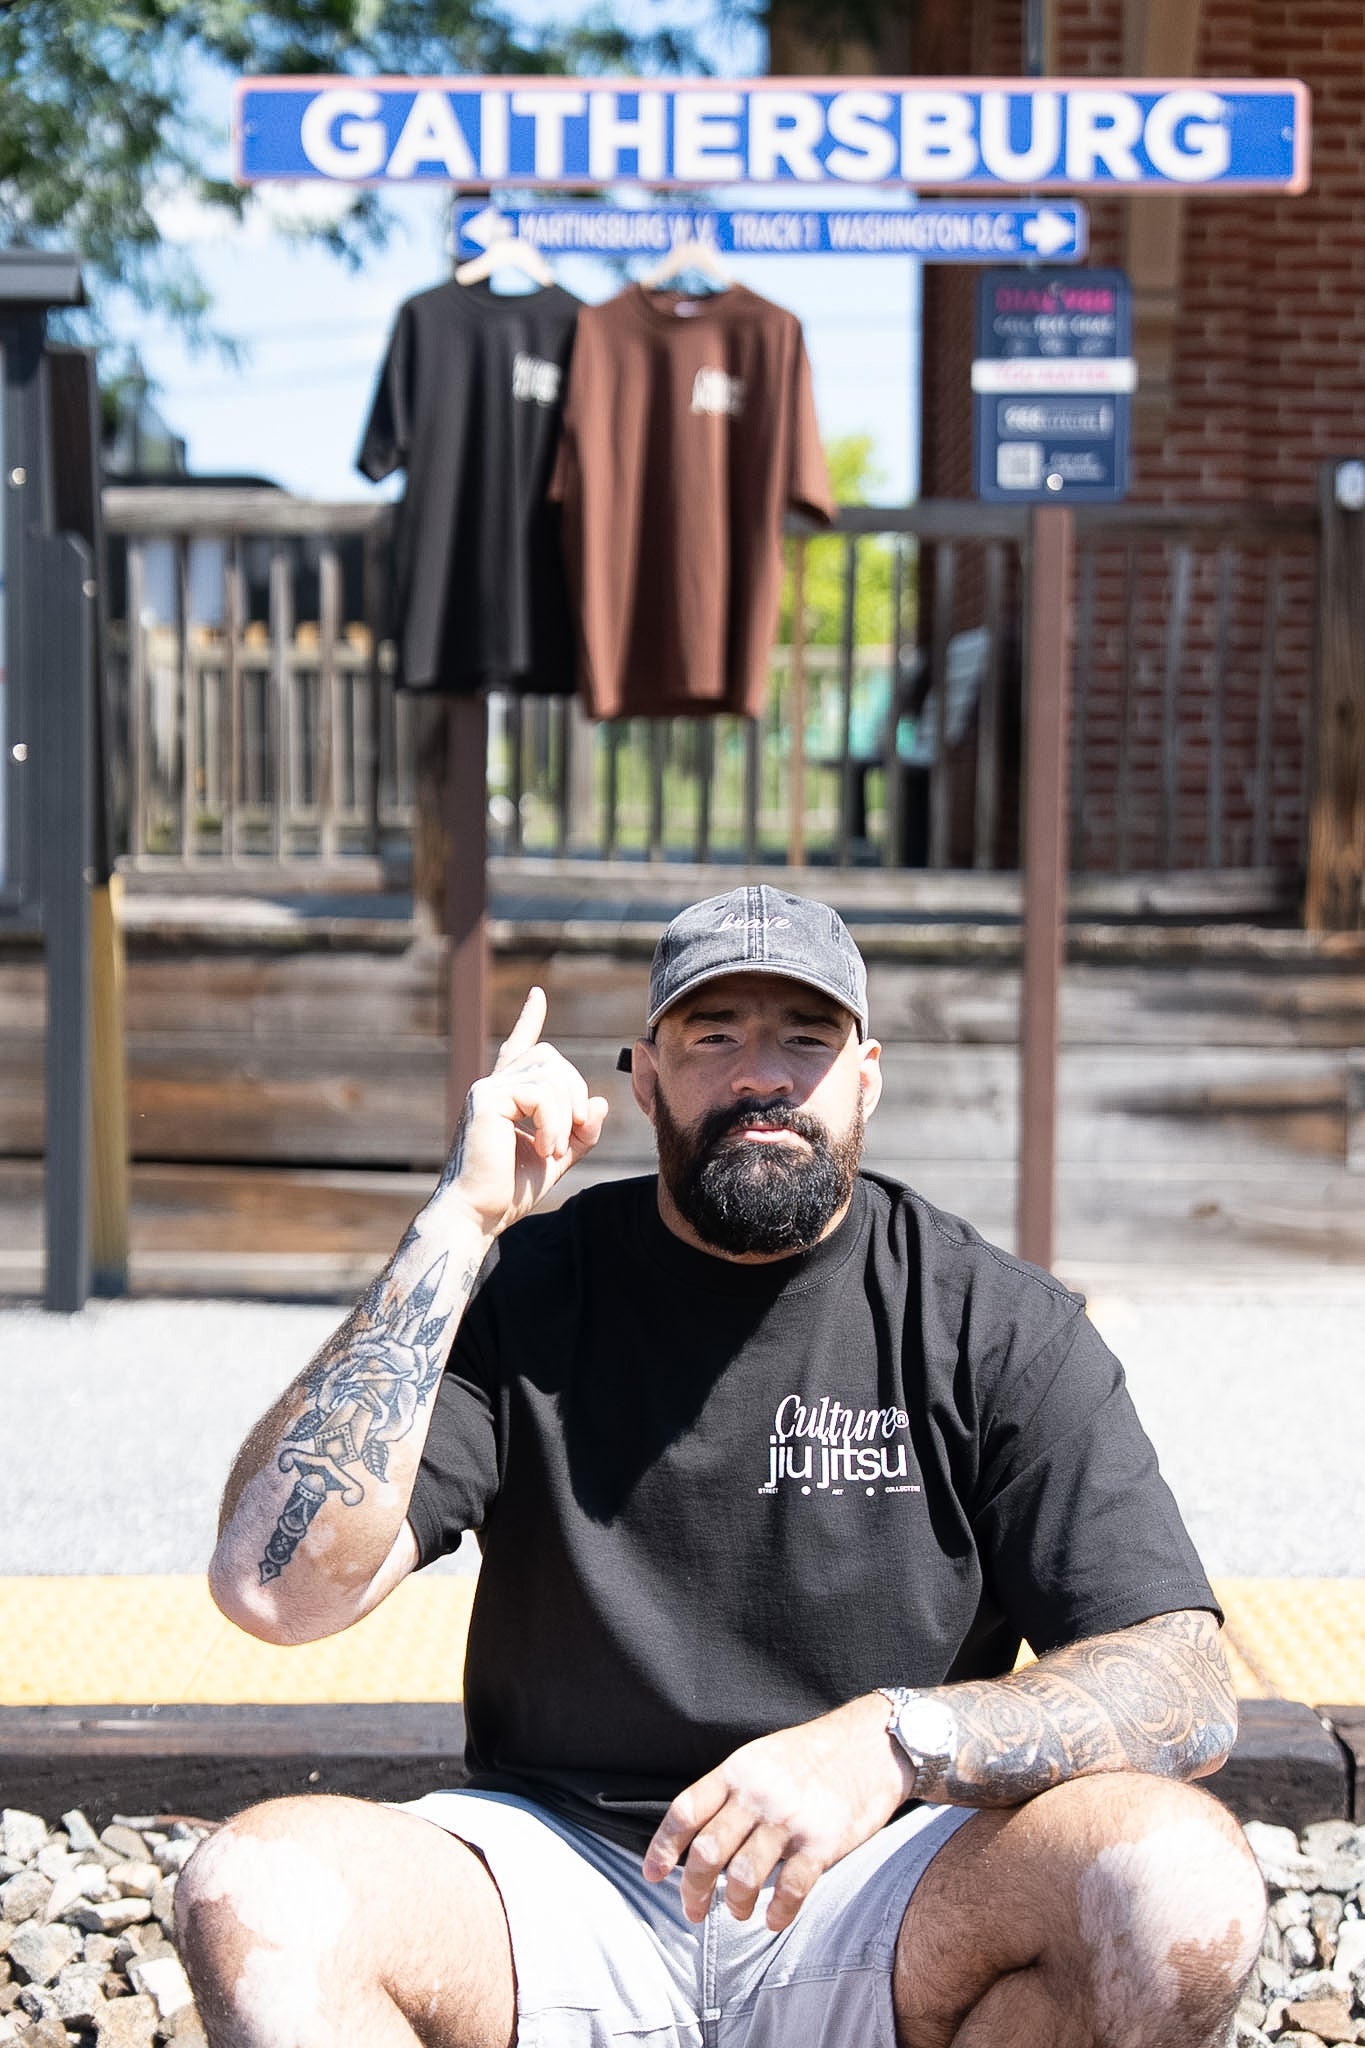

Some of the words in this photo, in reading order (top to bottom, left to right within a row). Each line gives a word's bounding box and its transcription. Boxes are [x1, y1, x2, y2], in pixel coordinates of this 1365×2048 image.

[301, 88, 1231, 182] GAITHERSBURG
[519, 212, 667, 249] MARTINSBURG
[730, 213, 801, 249] TRACK
[828, 213, 971, 250] WASHINGTON
